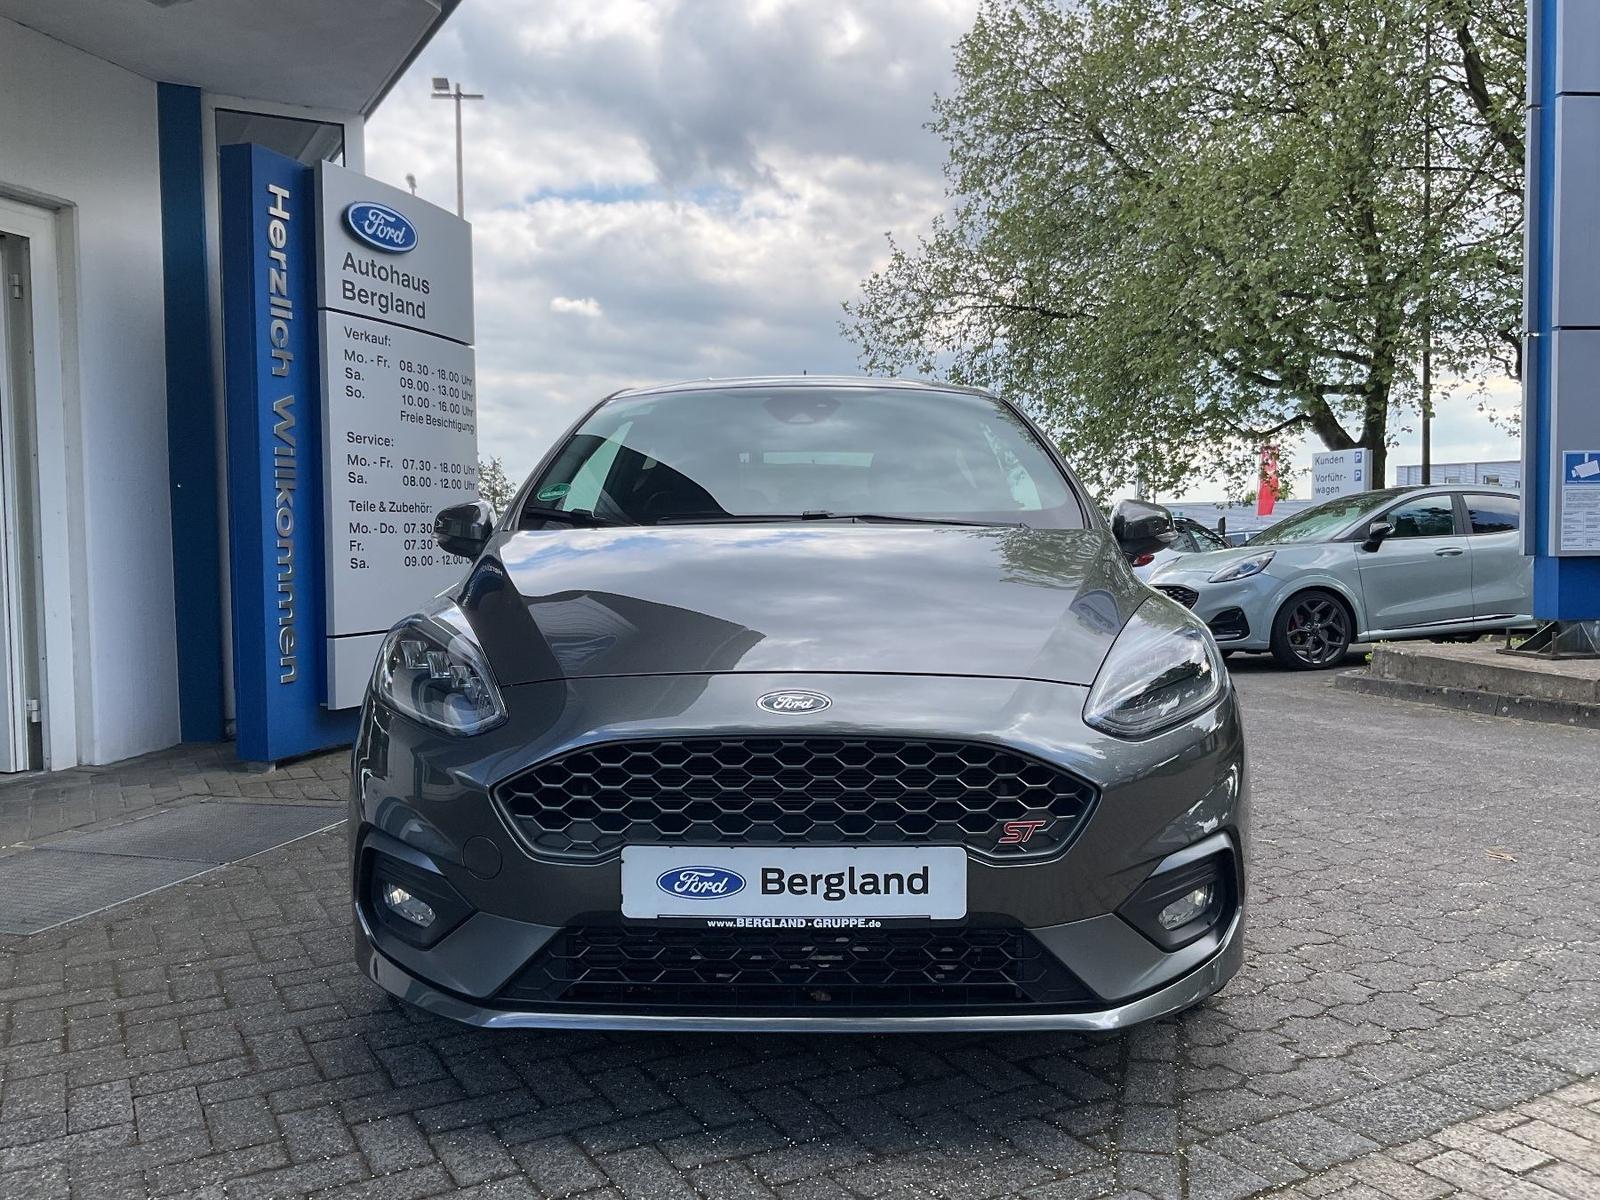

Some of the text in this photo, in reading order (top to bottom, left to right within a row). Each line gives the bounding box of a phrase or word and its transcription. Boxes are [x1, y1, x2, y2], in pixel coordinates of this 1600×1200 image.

[364, 209, 405, 245] Ford
[342, 252, 430, 295] Autohaus
[342, 279, 426, 319] Bergland
[344, 326, 391, 347] Verkauf:
[344, 349, 367, 364] Mo.
[377, 355, 390, 368] Fr.
[400, 360, 428, 376] 08.30
[437, 369, 459, 383] 18.00
[462, 374, 473, 386] Uhr
[345, 367, 364, 381] Sa.
[400, 377, 429, 392] 09.00
[438, 385, 459, 398] 13.00
[462, 390, 473, 401] Uhr
[345, 385, 365, 399] So.
[402, 395, 429, 408] 10.00
[439, 401, 460, 414] 16.00
[462, 406, 473, 417] Uhr
[400, 410, 475, 435] Freie Besichtigung
[267, 184, 297, 684] Herzlich Willkommen
[346, 431, 394, 447] Service:
[347, 454, 370, 467] Mo.
[380, 457, 393, 469] Fr.
[402, 458, 431, 472] 07.30
[440, 462, 461, 474] 18.00
[464, 465, 475, 475] Uhr
[1315, 456, 1344, 465] Kunden
[348, 472, 368, 484] Sa.
[402, 475, 431, 488] 08.00
[440, 478, 462, 490] 12.00
[464, 481, 475, 491] Uhr
[1315, 473, 1346, 483] Vorführ-
[1315, 485, 1339, 495] wagen
[349, 500, 433, 513] Teile & Zubehör:
[350, 522, 371, 534] Mo.
[379, 523, 398, 534] Do.
[404, 523, 433, 534] 07.30
[350, 540, 364, 551] Fr.
[404, 540, 433, 550] 07.30
[350, 558, 369, 569] Sa.
[404, 556, 433, 567] 09.00
[442, 555, 462, 565] 12.00
[773, 696, 814, 709] Ford
[998, 820, 1046, 844] ST
[674, 866, 929, 901] Ford Bergland
[707, 917, 881, 928] www.BERGLAND-GRUPPE.de
